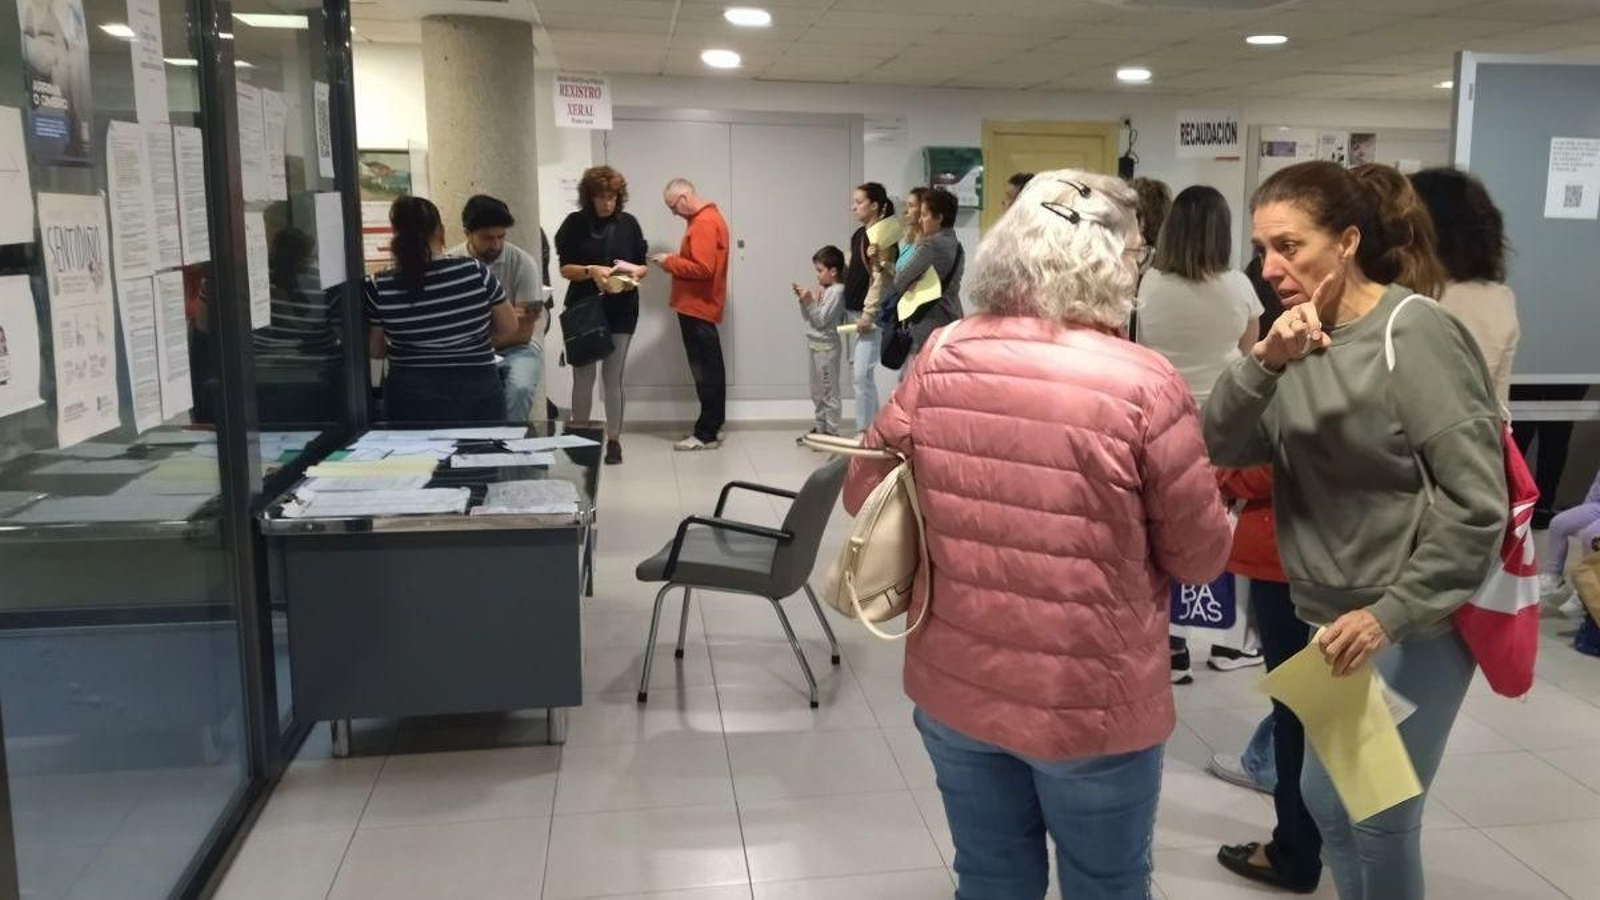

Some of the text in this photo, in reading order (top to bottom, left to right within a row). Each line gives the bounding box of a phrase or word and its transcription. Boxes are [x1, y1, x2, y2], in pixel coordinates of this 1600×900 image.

[559, 84, 601, 100] REXISTRO
[567, 103, 595, 117] XERAL
[1180, 118, 1237, 146] RECAUDACIÓN
[1181, 583, 1214, 602] BA
[1179, 601, 1222, 622] JAS
